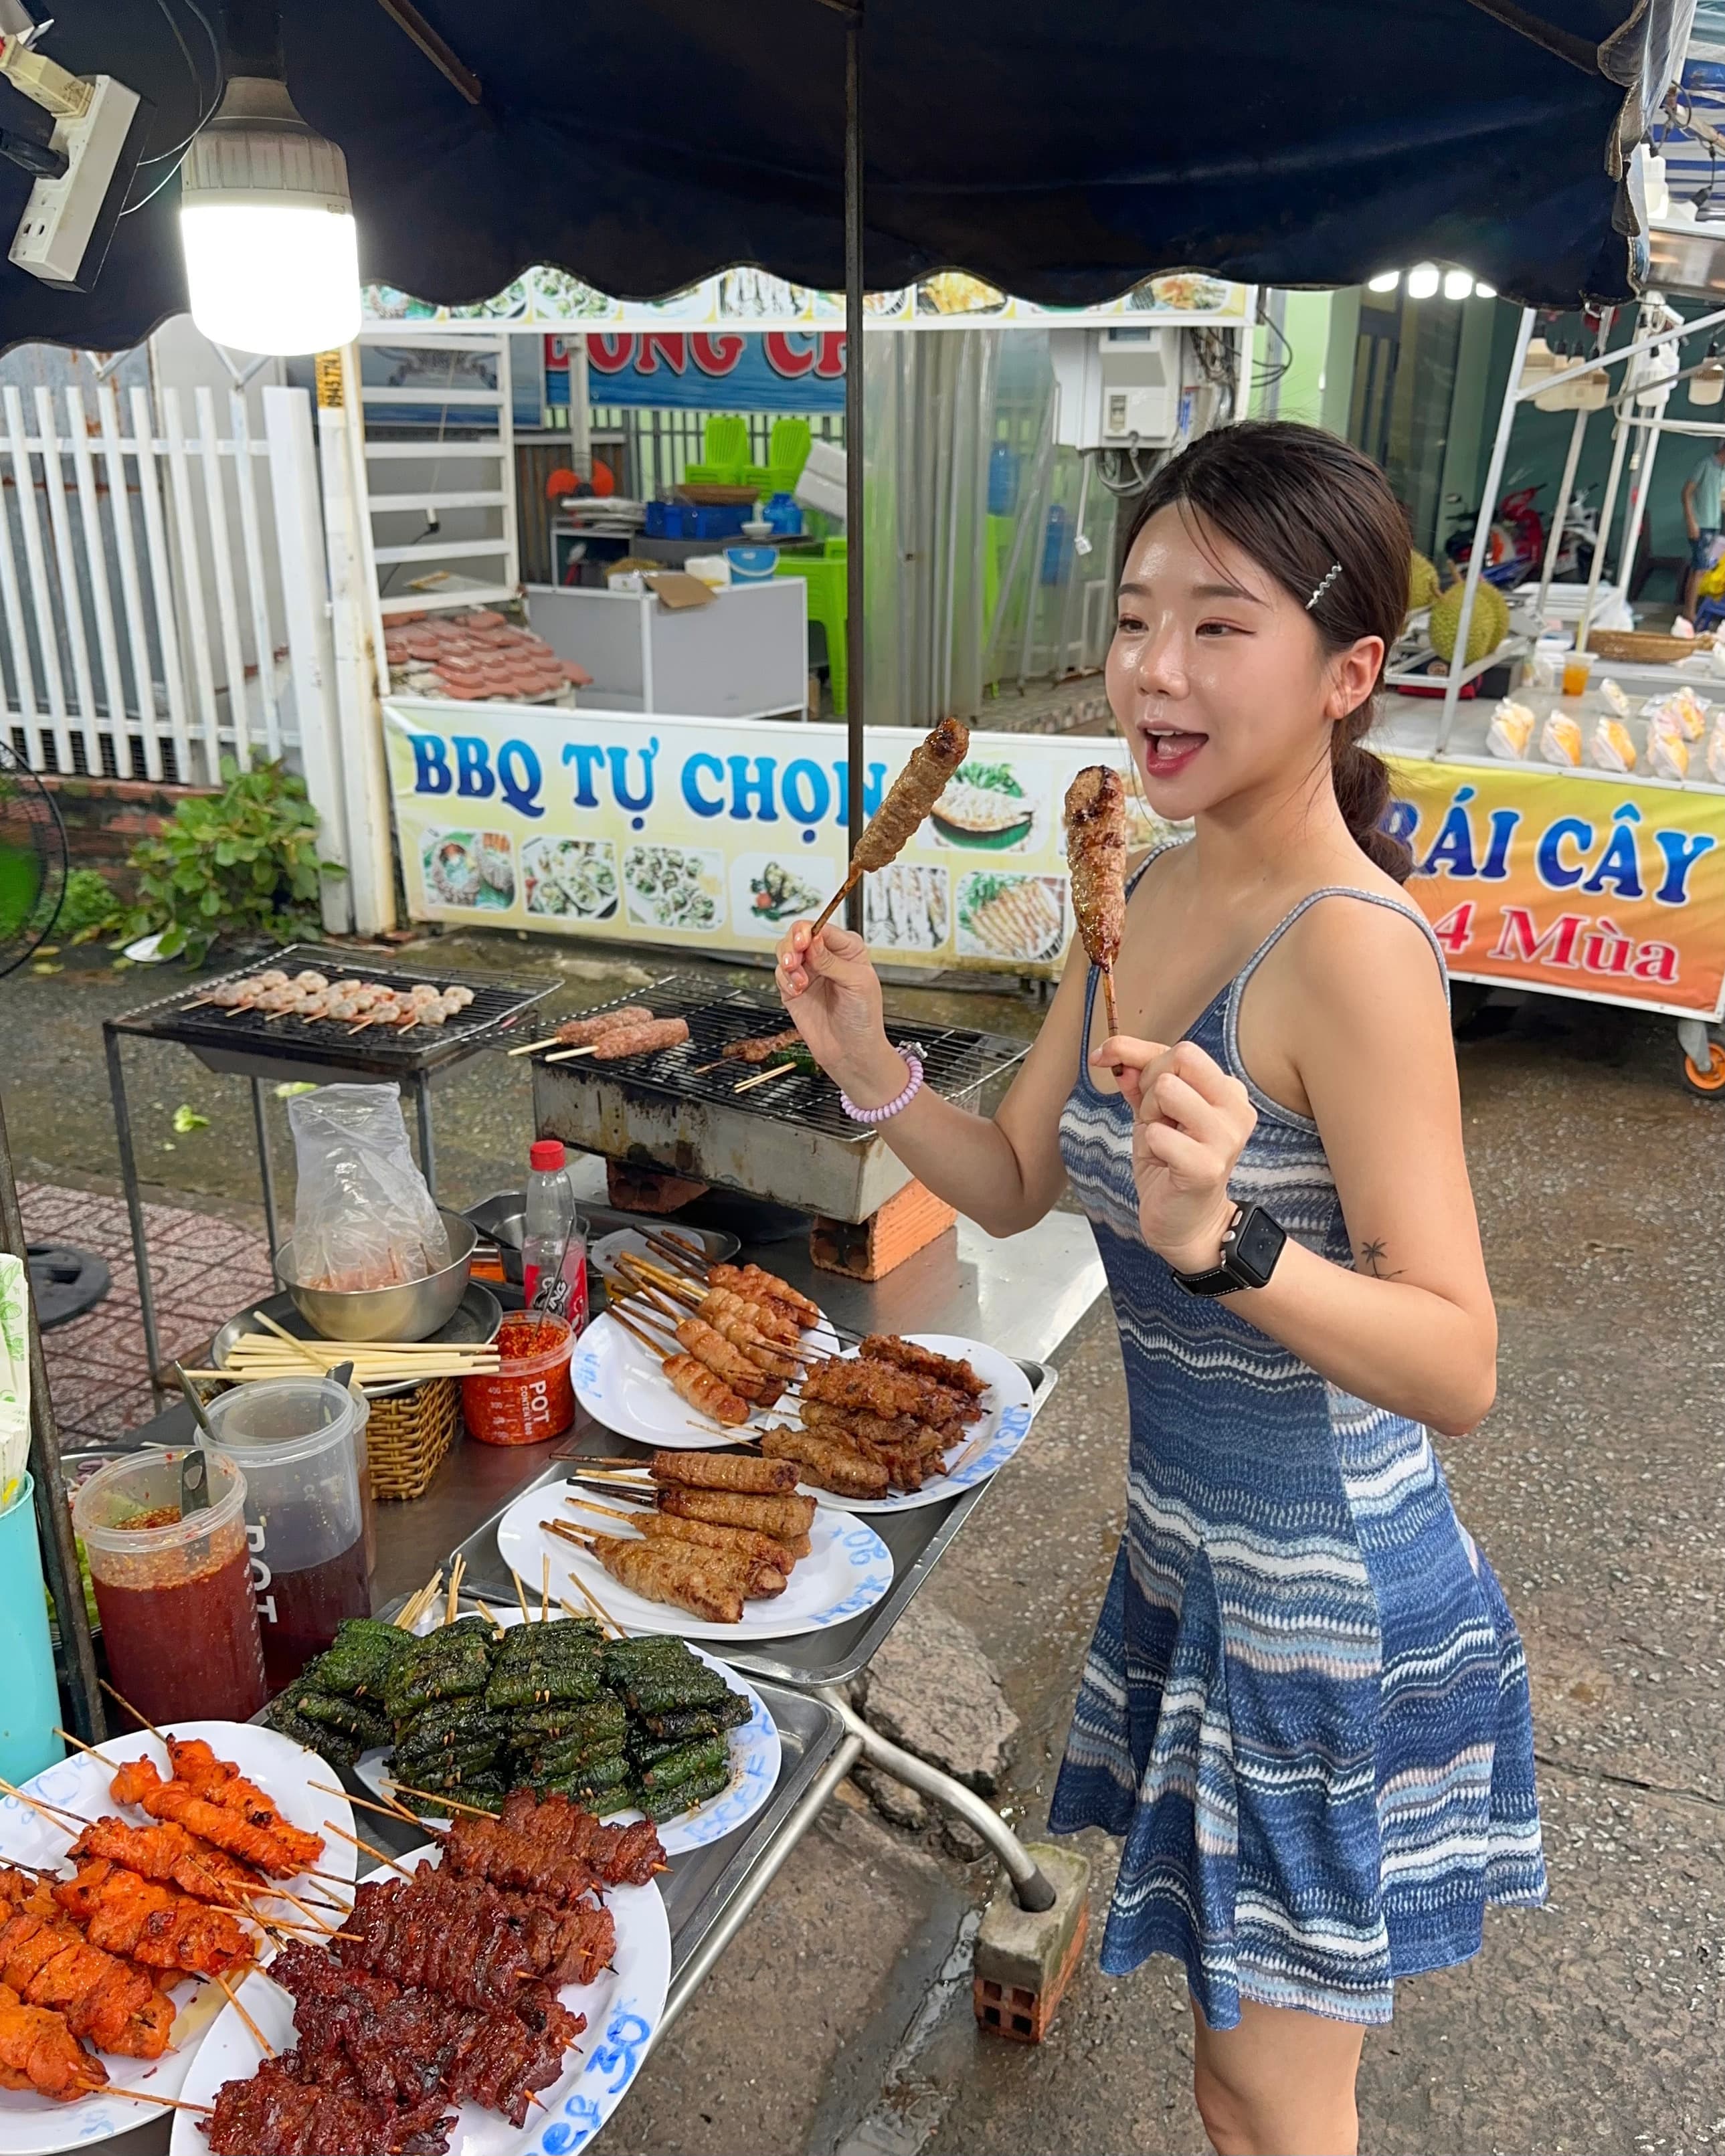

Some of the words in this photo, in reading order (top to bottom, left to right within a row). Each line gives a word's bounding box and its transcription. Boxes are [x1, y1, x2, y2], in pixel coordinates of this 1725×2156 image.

[407, 733, 546, 819] BBQ
[561, 734, 660, 831] TỰ
[680, 751, 888, 845] CHỌN
[1536, 800, 1717, 907] CÂY
[1487, 904, 1680, 985] Mùa
[529, 1380, 550, 1423] POT
[246, 1525, 278, 1624] POT
